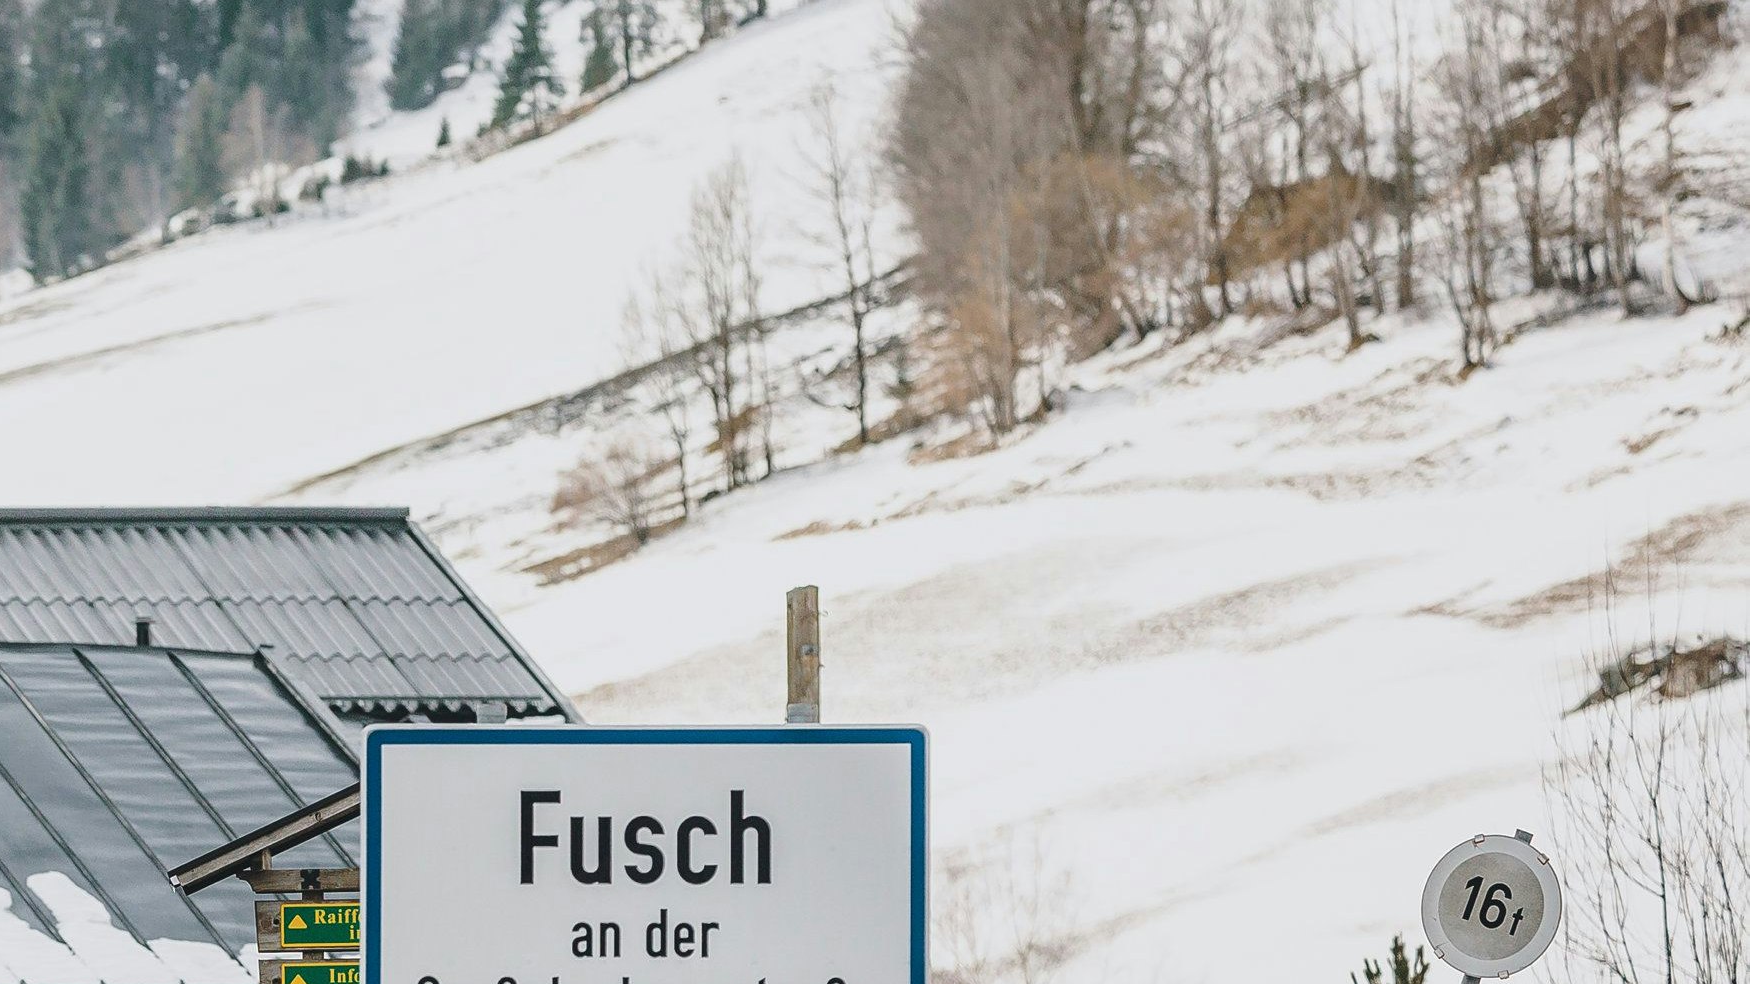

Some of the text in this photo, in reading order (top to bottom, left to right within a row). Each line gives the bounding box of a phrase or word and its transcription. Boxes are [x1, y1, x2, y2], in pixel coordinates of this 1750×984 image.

[520, 789, 772, 886] Fusch
[314, 908, 360, 925] Raiff
[571, 908, 720, 958] an der
